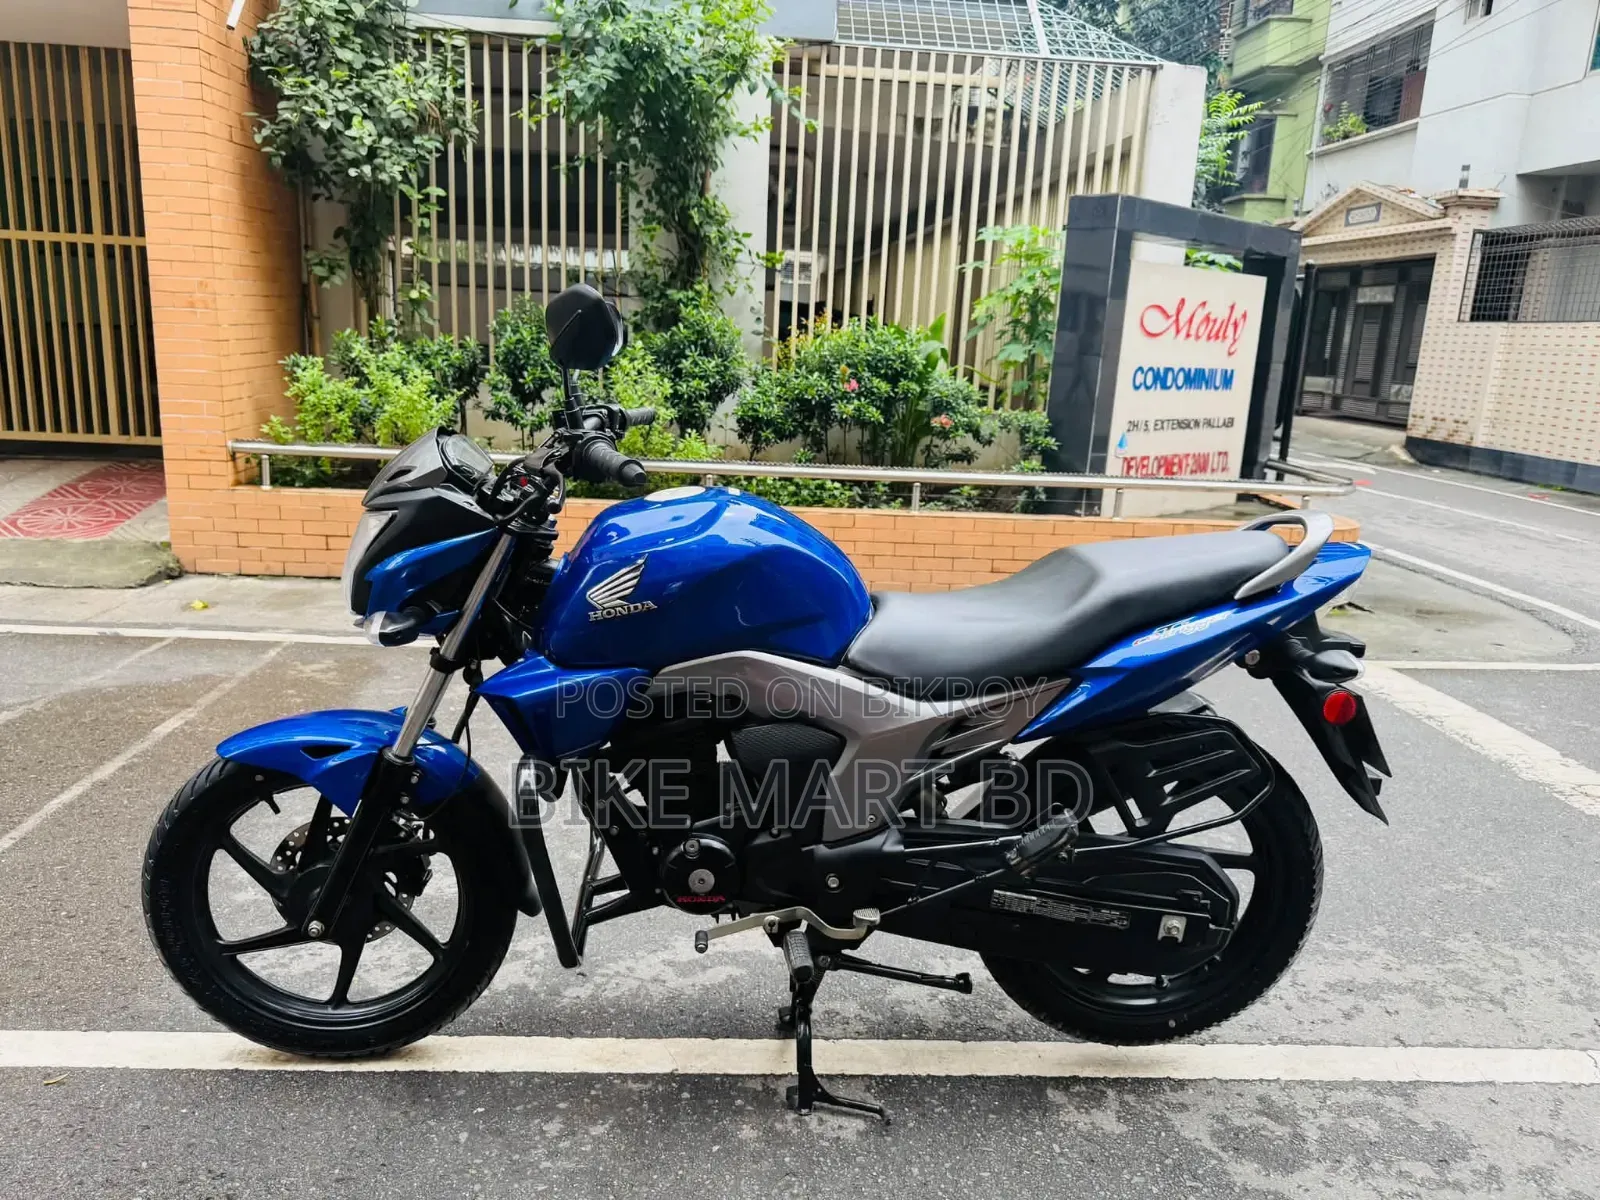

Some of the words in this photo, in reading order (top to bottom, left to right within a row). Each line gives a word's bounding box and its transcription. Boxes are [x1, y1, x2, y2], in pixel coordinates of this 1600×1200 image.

[1140, 298, 1248, 356] Mouly
[1132, 366, 1235, 391] CONDOMINIUM
[1153, 418, 1201, 431] EXTENSION
[587, 600, 658, 622] HONDA
